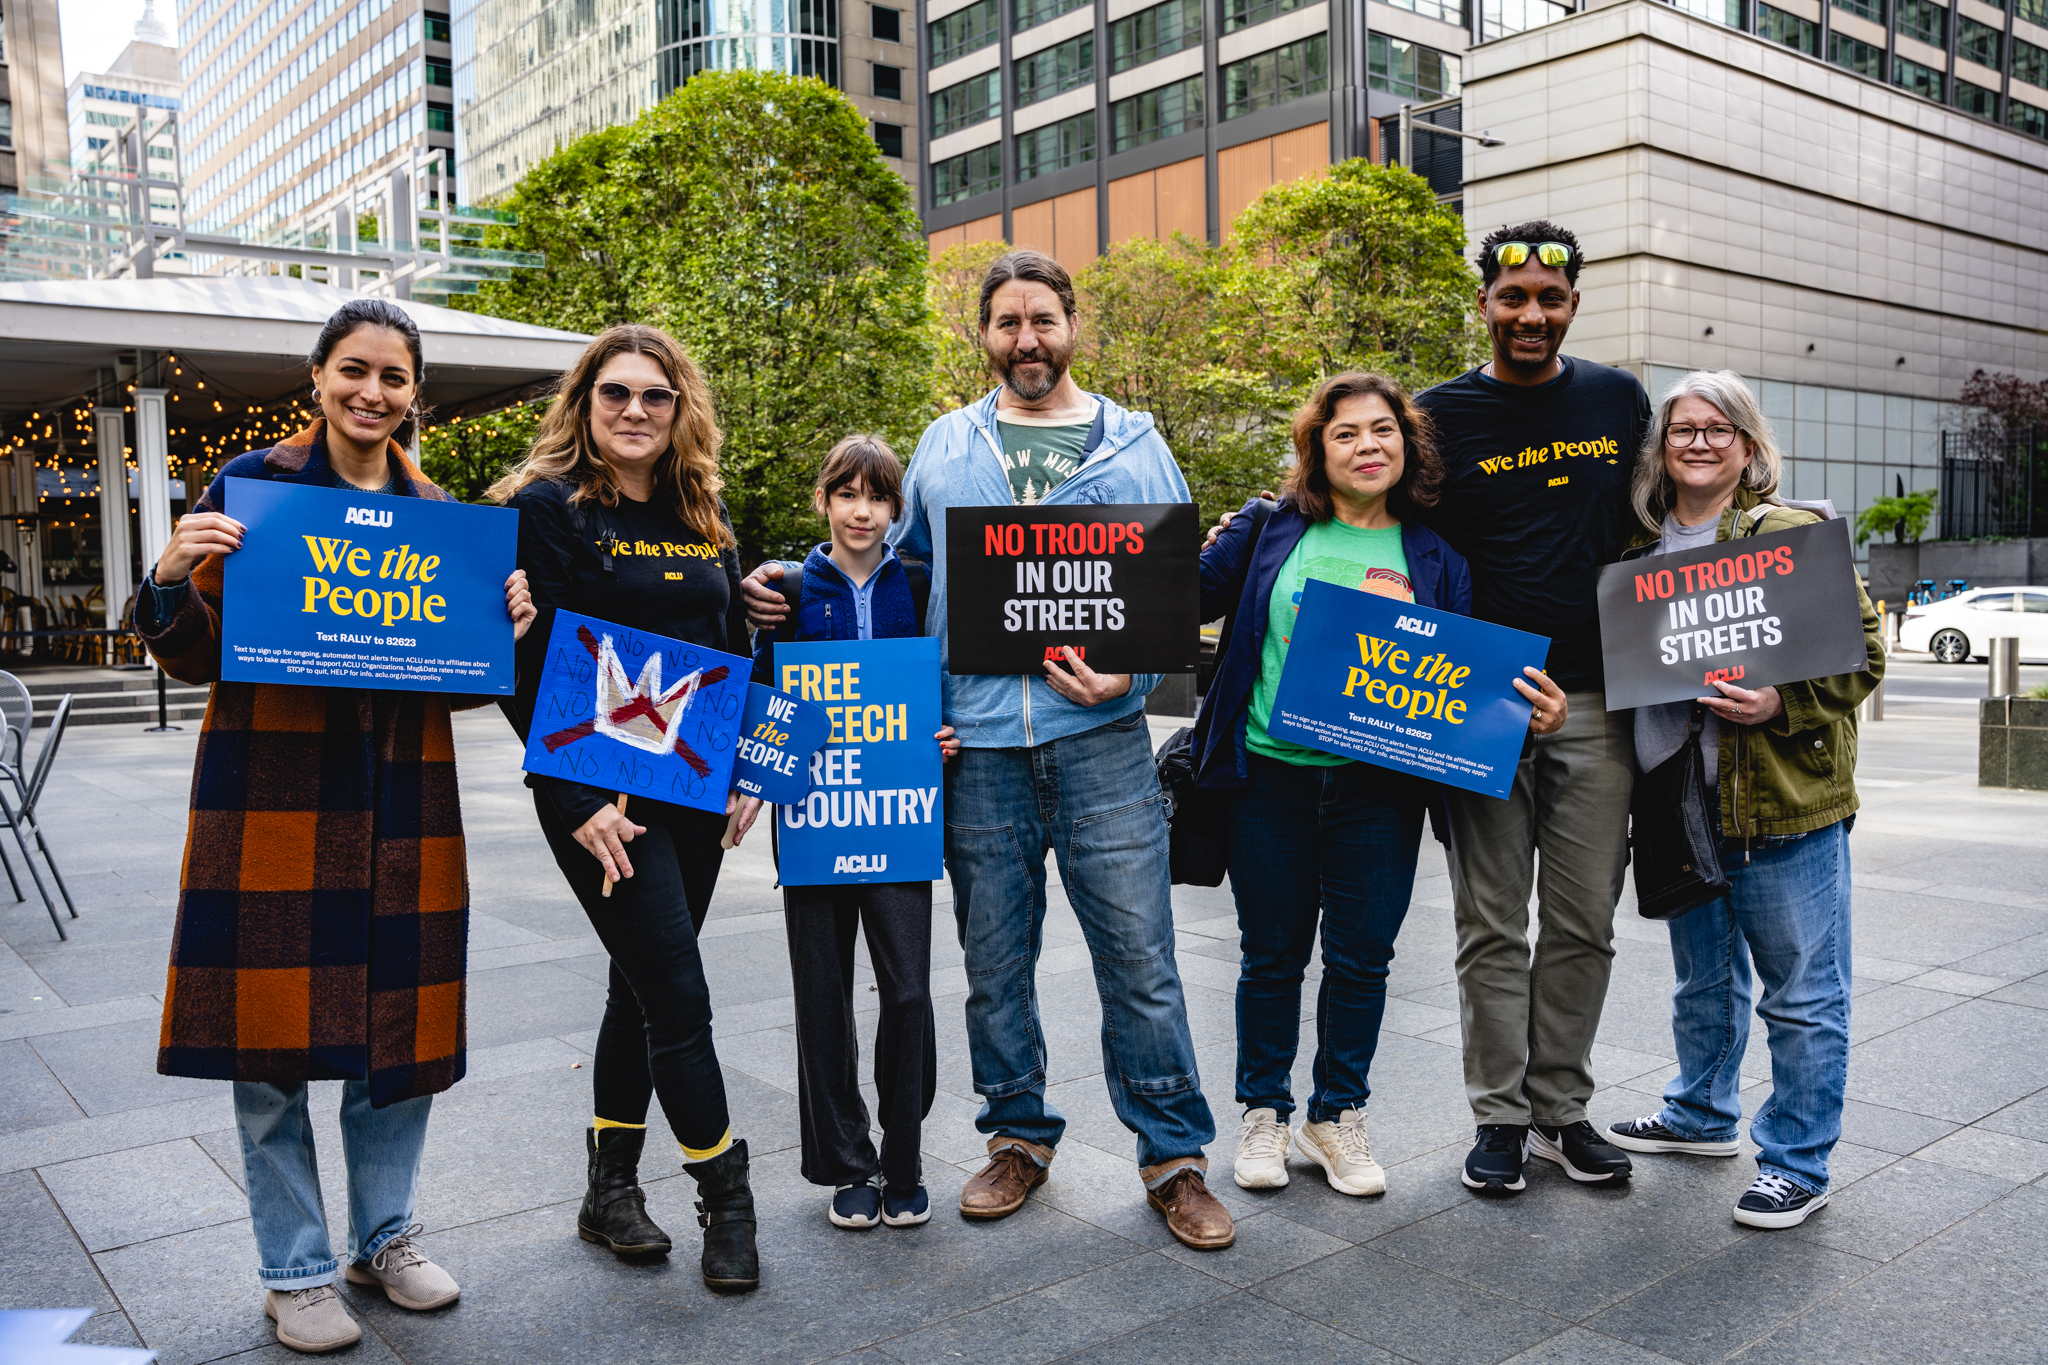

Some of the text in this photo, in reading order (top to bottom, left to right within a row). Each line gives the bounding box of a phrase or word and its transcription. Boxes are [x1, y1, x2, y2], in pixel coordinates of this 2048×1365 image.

[1478, 436, 1618, 475] We the People
[1548, 476, 1569, 487] ACLU
[345, 507, 392, 528] ACLU
[634, 540, 660, 557] the
[985, 522, 1144, 556] NO TROOPS
[302, 534, 440, 582] We the
[1635, 546, 1794, 602] NO TROOPS
[664, 572, 683, 580] ACLU
[1017, 560, 1112, 593] IN OUR
[302, 576, 446, 626] People
[1004, 598, 1125, 632] STREETS
[1668, 586, 1766, 629] IN OUR
[316, 632, 416, 647] Text RALLY to 82623
[1394, 615, 1437, 637] ACLU
[1660, 616, 1782, 665] STREETS
[258, 647, 271, 656] sign
[362, 662, 405, 671] Organizations.
[407, 665, 437, 673] Msg&Data
[667, 646, 699, 670] NO
[1044, 646, 1085, 661] ACU
[1356, 633, 1470, 689] We the
[375, 671, 442, 682] aclu.org/privacypolicy.
[782, 663, 860, 701] FREE
[1704, 665, 1745, 686] ACLU
[548, 691, 590, 719] NO
[702, 682, 739, 720] NO
[766, 695, 798, 724] WE
[1342, 666, 1467, 724] People
[753, 721, 790, 746] the
[826, 704, 907, 743] EECH
[1349, 712, 1366, 723] Text
[1367, 717, 1394, 730] RALLY
[1406, 728, 1432, 740] 82623
[1315, 728, 1331, 736] action
[1343, 735, 1363, 744] support
[1380, 744, 1416, 758] Organizations.
[1418, 754, 1445, 766] Msg&Data
[1472, 769, 1487, 777] apply.
[1327, 724, 1348, 734] ongoing,
[1350, 730, 1377, 740] automated
[1454, 757, 1476, 767] affiliates
[1478, 763, 1493, 771] about
[558, 747, 706, 799] NO NO NO
[809, 749, 862, 786] REE
[737, 779, 762, 794] ACLU
[784, 787, 938, 828] COUNTRY
[834, 854, 887, 873] ACLU
